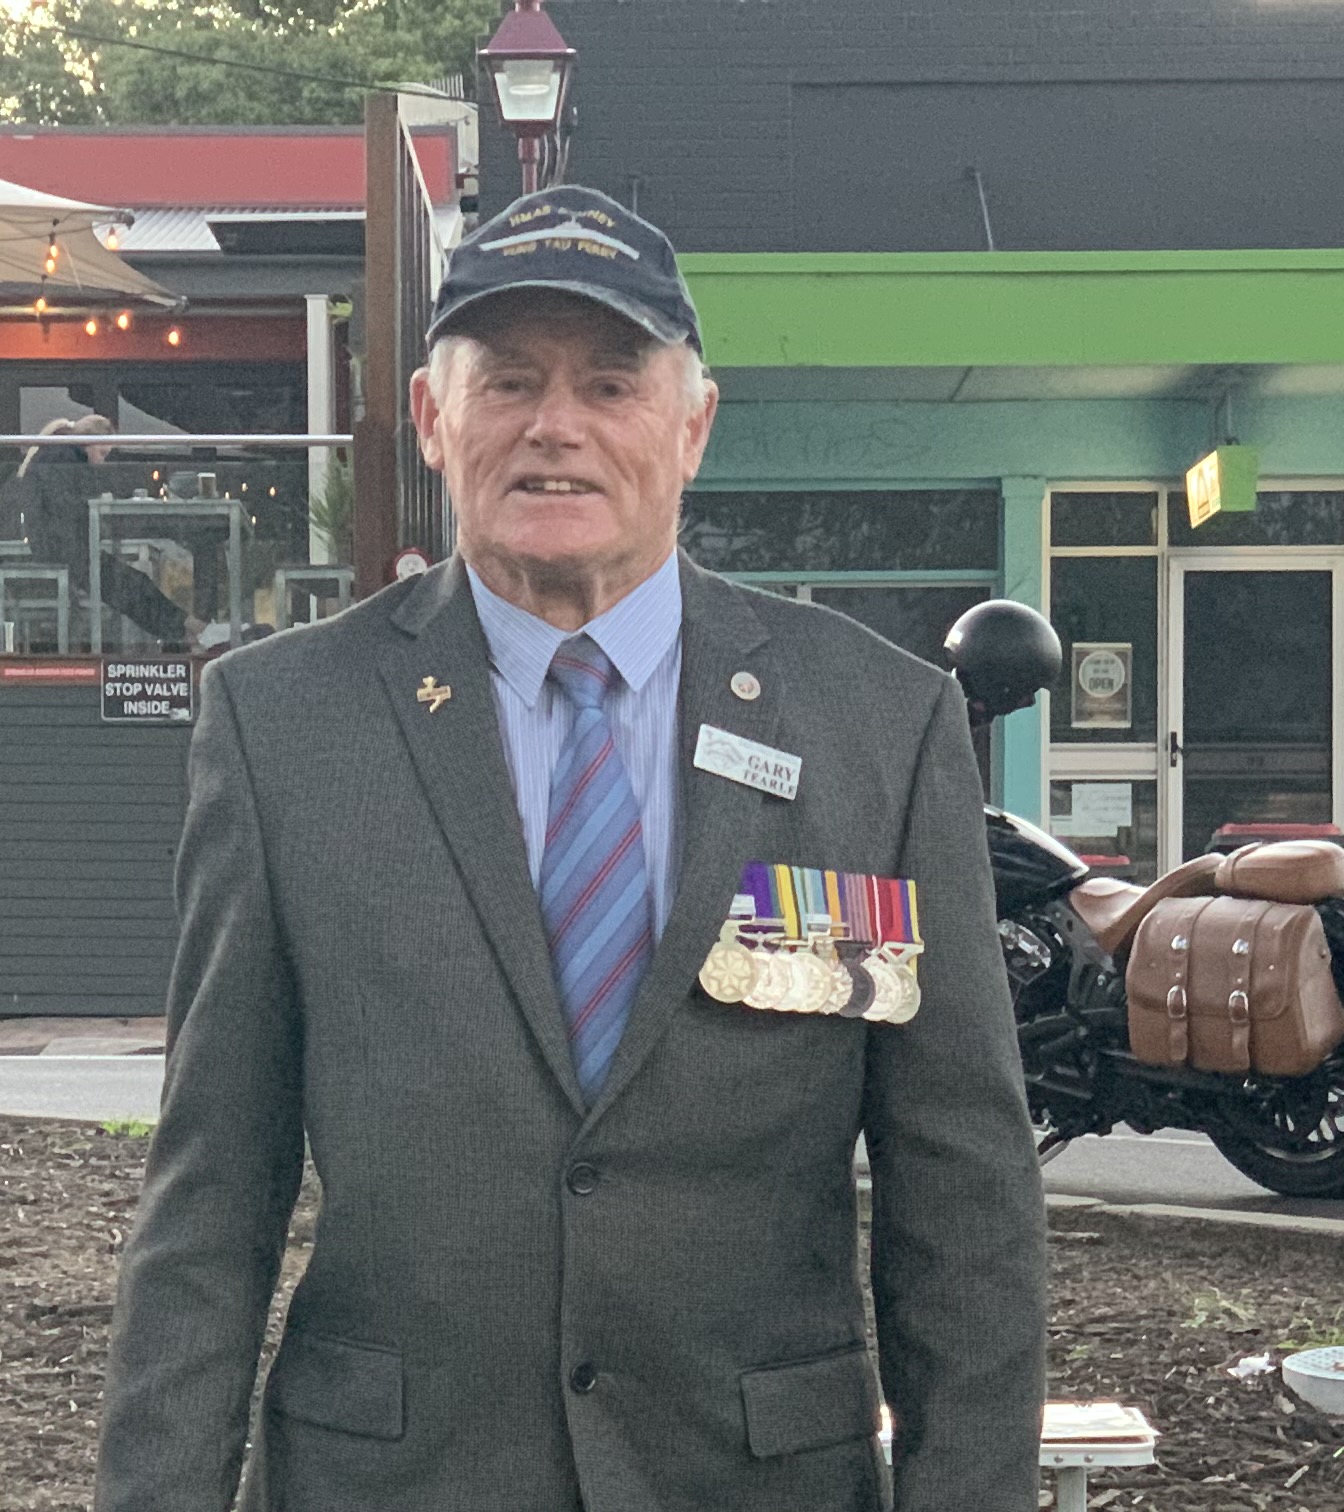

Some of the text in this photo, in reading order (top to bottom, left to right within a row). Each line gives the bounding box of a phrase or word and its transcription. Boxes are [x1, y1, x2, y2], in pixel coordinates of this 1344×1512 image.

[107, 664, 186, 678] SPRINKLER
[105, 682, 188, 697] STOP VALVE
[1088, 677, 1115, 692] OPEN
[123, 701, 171, 715] INSIDE
[747, 754, 794, 782] GARY
[743, 769, 796, 795] TEARLE
